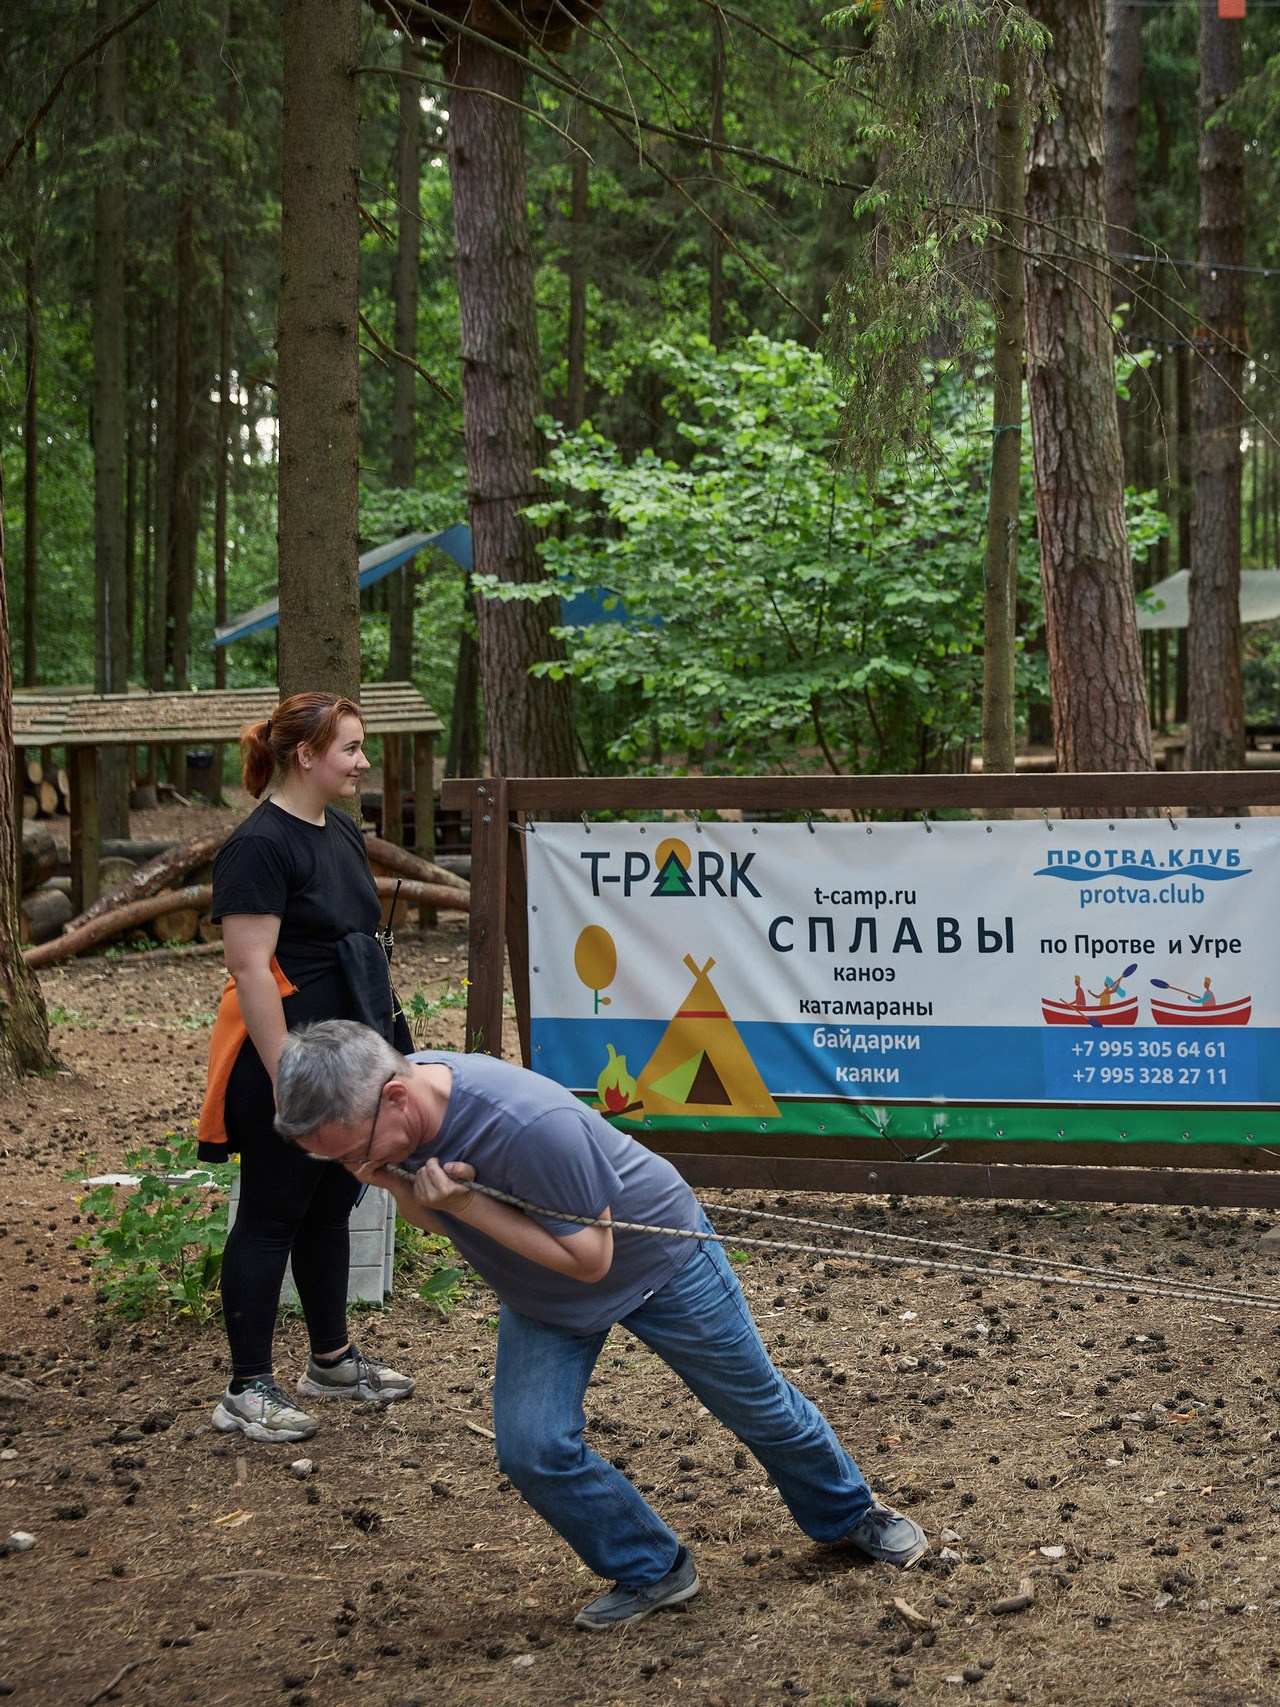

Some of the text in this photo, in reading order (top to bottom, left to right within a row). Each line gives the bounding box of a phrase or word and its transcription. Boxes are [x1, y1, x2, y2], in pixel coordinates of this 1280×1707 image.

[1047, 848, 1241, 868] ПРОТВА.КЛУБ
[580, 850, 762, 898] T-PARK
[814, 887, 917, 909] t-camp.ru
[1080, 883, 1205, 908] protva.club
[768, 915, 1242, 959] СПЛАВЫ по Протве и Угре
[833, 966, 896, 982] каноэ
[799, 999, 934, 1020] катамараны
[813, 1027, 921, 1054] байдарки
[1071, 1041, 1226, 1058] +7 995 305 64 61
[835, 1066, 900, 1083] каяки
[1073, 1067, 1227, 1085] +7 995 328 27 11
